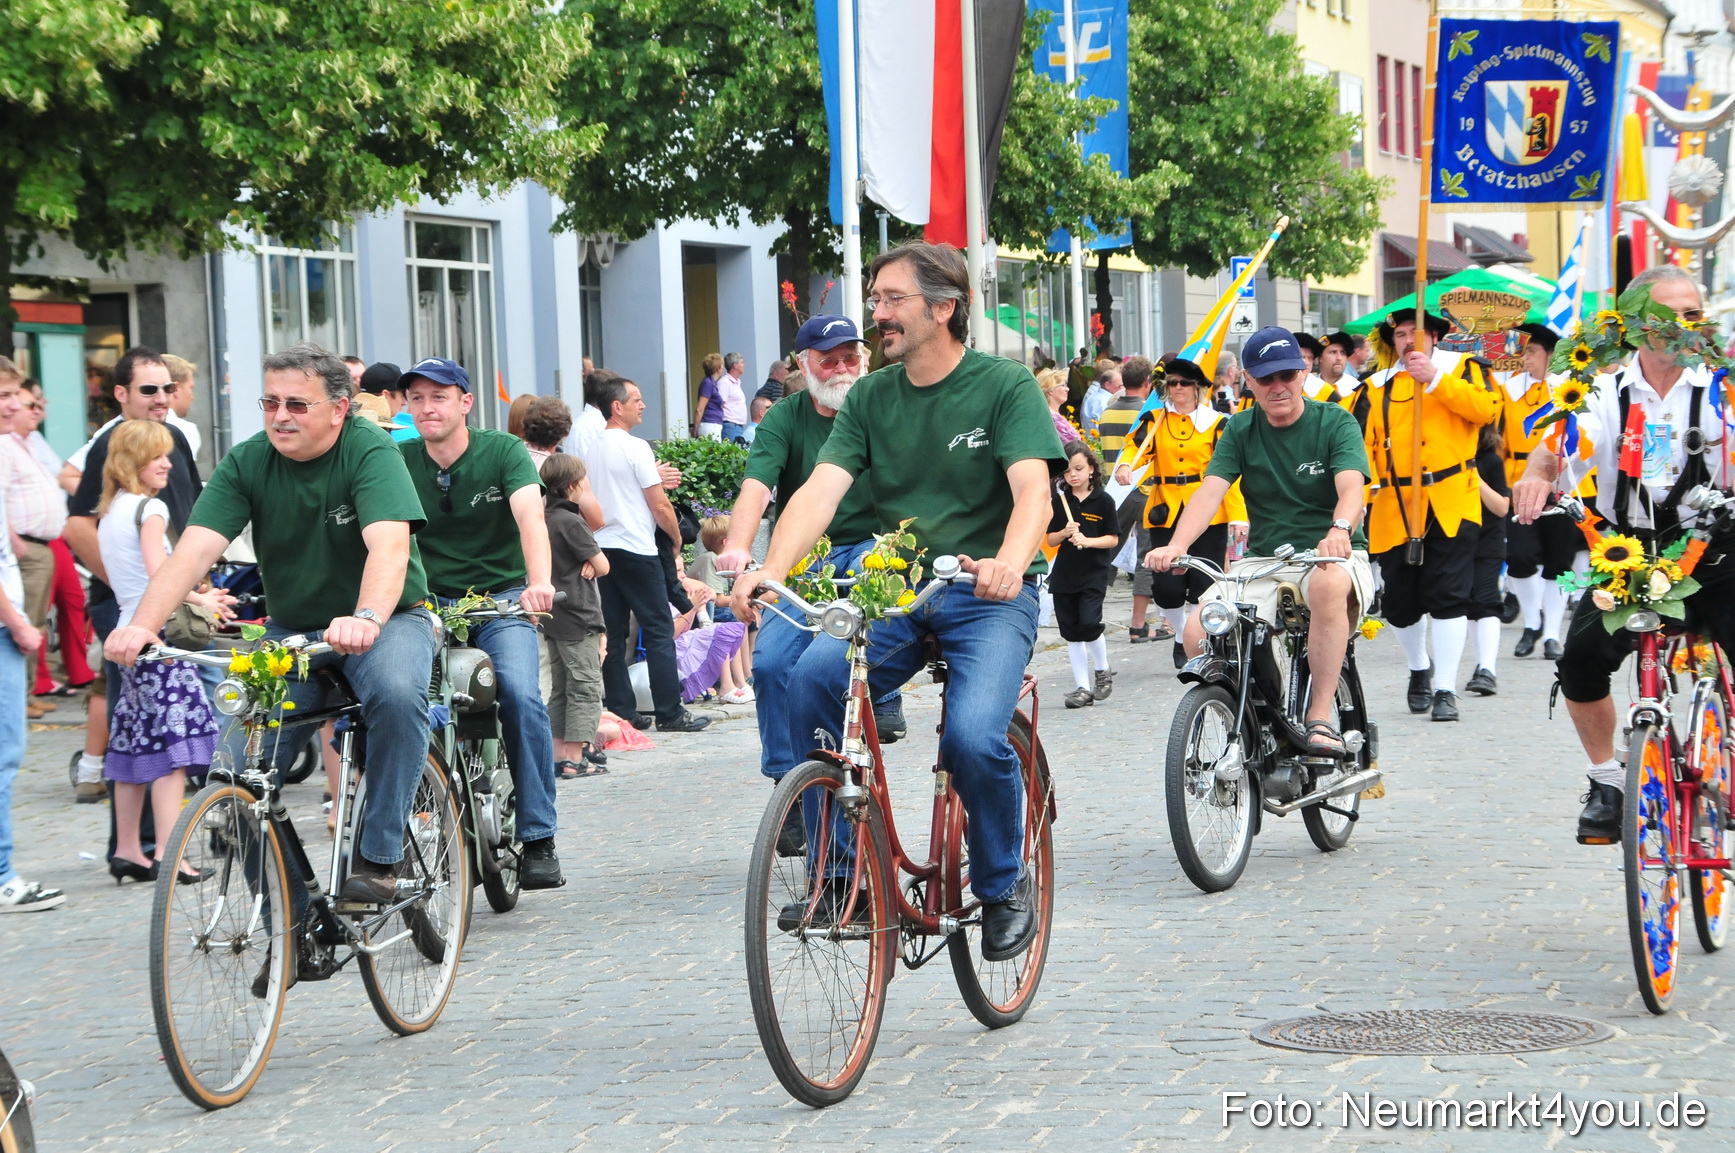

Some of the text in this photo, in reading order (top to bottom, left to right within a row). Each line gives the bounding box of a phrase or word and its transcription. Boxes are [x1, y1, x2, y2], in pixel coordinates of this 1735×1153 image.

[1452, 44, 1597, 107] Kolping-Spielmannszug
[1459, 117, 1589, 135] 19 57
[1455, 143, 1587, 190] Beratzhausen
[1440, 291, 1531, 311] SPIELMANNSZUG
